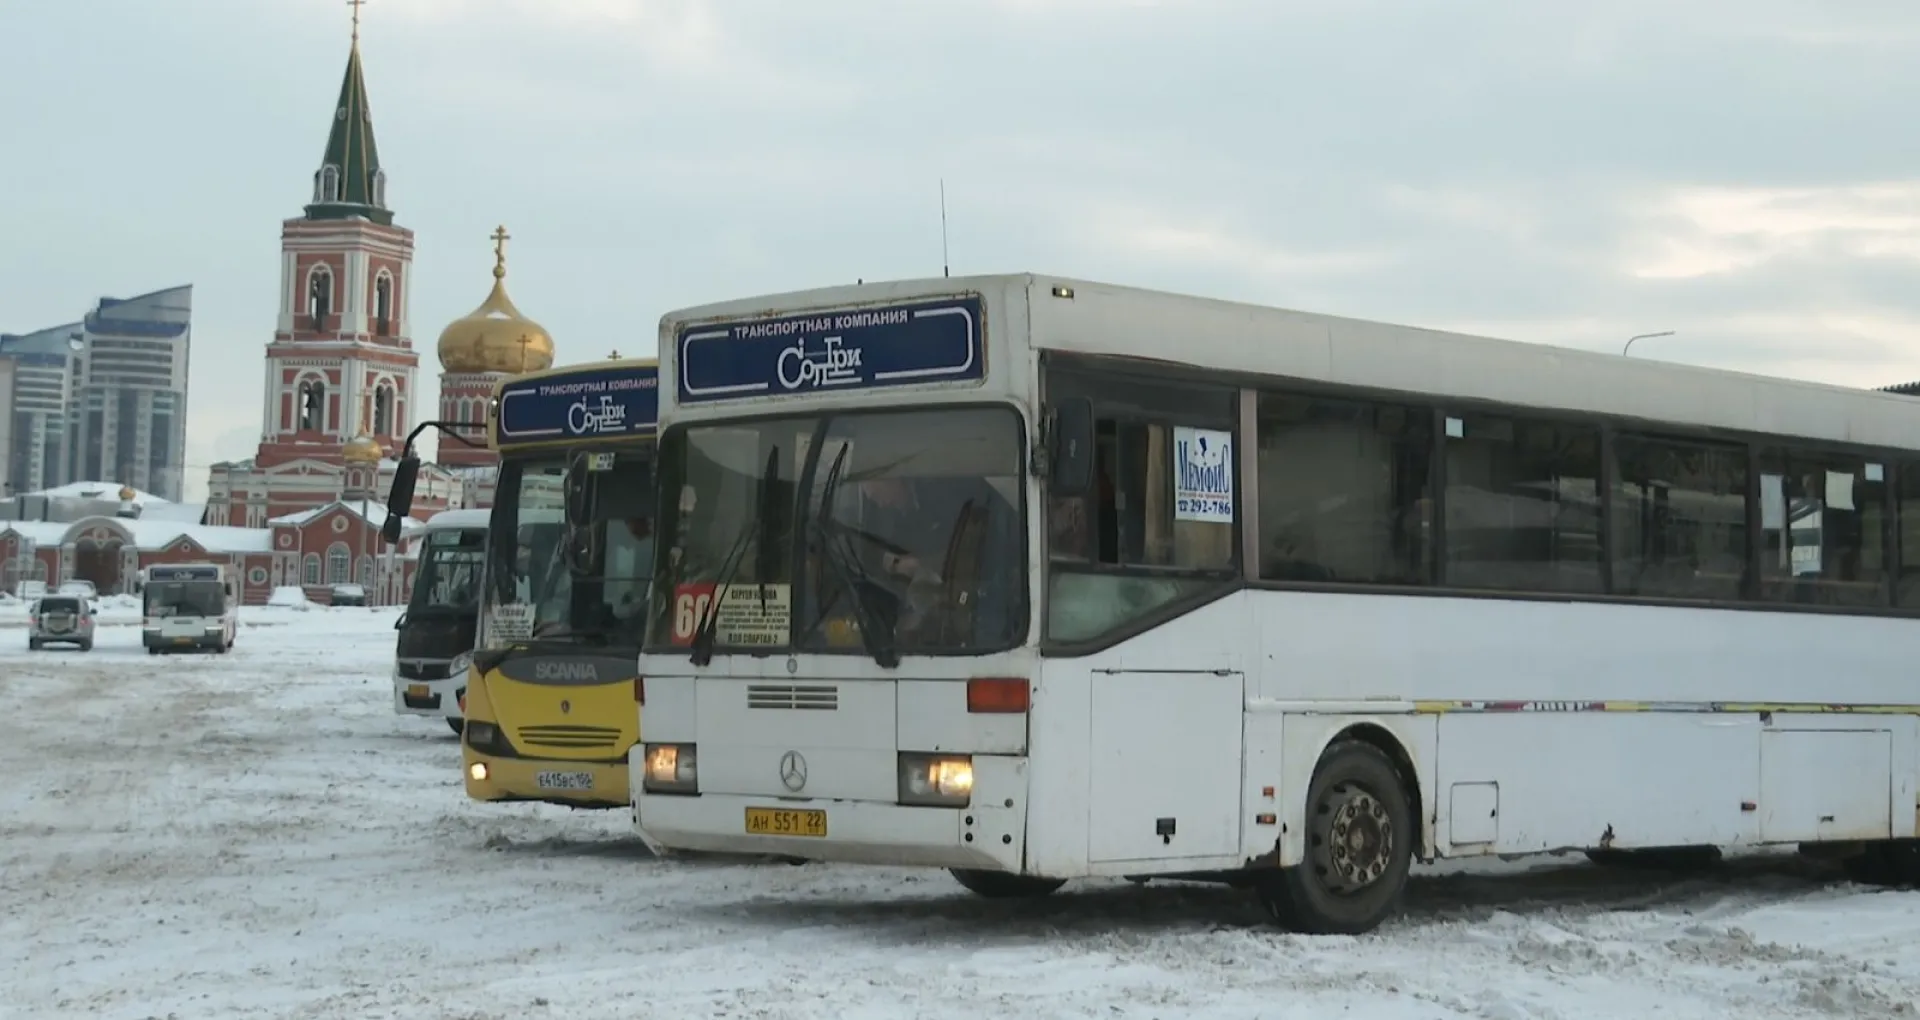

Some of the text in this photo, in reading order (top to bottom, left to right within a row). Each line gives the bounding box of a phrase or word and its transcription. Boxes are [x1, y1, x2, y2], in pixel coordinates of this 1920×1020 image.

[735, 310, 908, 340] ТРАНСПОРТНАЯ КОМПАНИЯ
[539, 381, 607, 397] ТРАНСПОРТНАЯ
[1190, 499, 1231, 515] 292-786
[535, 661, 598, 681] SCANIA
[774, 812, 799, 832] 551
[807, 812, 821, 828] 22
